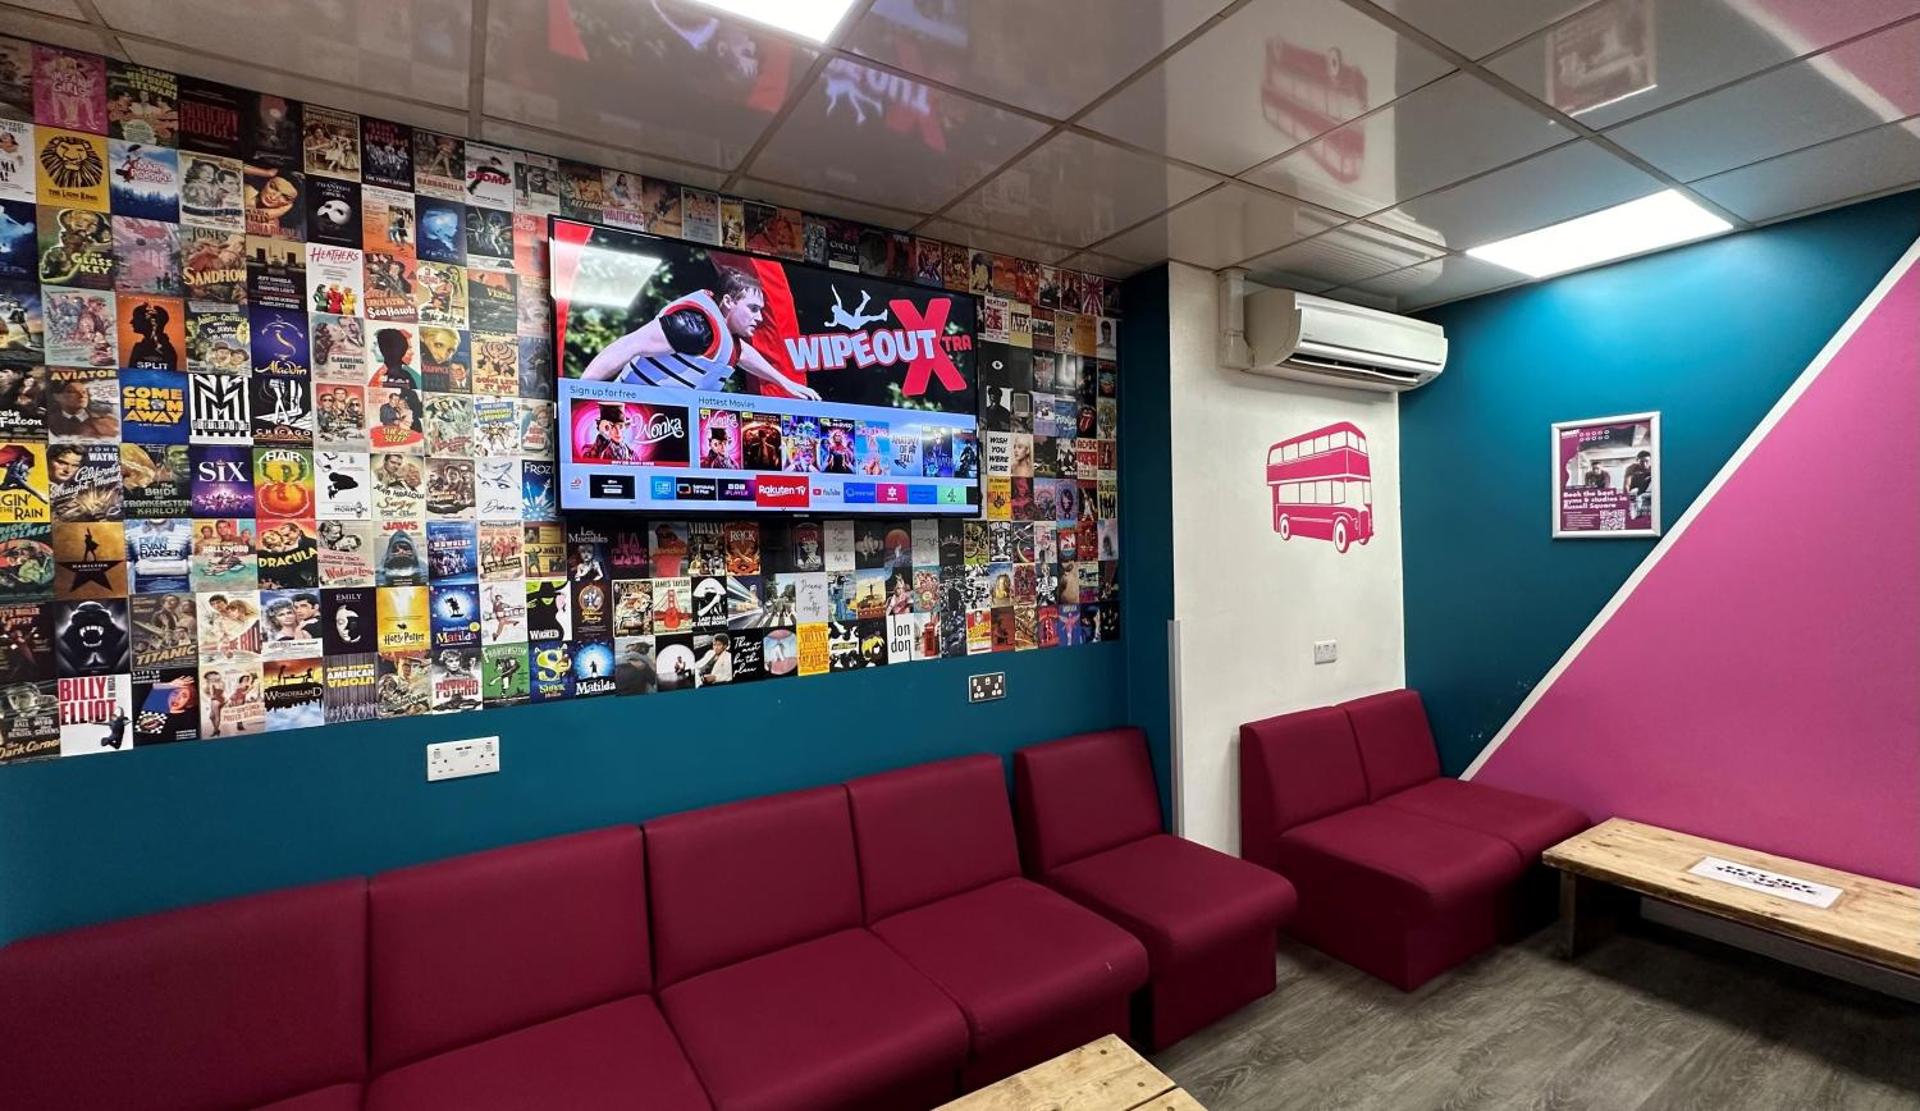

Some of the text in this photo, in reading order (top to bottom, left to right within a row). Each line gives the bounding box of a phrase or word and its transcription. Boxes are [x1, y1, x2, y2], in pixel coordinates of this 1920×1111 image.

[467, 170, 511, 186] STOMP
[191, 227, 229, 241] JONES
[70, 252, 112, 267] GLASS
[310, 247, 360, 263] HEATHERS
[80, 264, 109, 275] KEY
[784, 329, 938, 371] WIPEOUT
[137, 361, 168, 370] SPLIT
[255, 360, 307, 376] Aladdin
[51, 370, 118, 382] AVIATOR
[123, 387, 183, 400] COME
[569, 385, 637, 399] Sign up for free
[123, 399, 184, 411] FROM
[698, 396, 755, 409] Hottest Movies
[123, 411, 184, 424] AWAY
[256, 427, 312, 436] CHICAGO
[632, 412, 684, 443] Wonka
[991, 446, 1006, 454] YOU
[89, 452, 119, 462] WAYNE
[265, 451, 301, 463] HAIR
[989, 455, 1009, 463] WERE
[989, 464, 1009, 472] HERE
[145, 488, 178, 496] BRIDE
[759, 484, 806, 498] Rakuten TV
[124, 499, 192, 508] FRANKENSTEIN
[15, 506, 44, 521] RAIN
[137, 507, 187, 516] KARLOFF
[383, 521, 418, 531] JAWS
[689, 521, 726, 534] NIRVANA
[730, 529, 756, 543] ROCK
[139, 543, 168, 551] EVAN
[203, 545, 249, 553] HOLLYWOOD
[139, 549, 183, 559] HANSEN
[259, 548, 317, 569] DRACULA
[336, 593, 362, 601] EMILY
[894, 614, 911, 637] lon
[436, 629, 478, 646] Matilda
[530, 629, 559, 640] WICKED
[136, 645, 196, 665] TITANIC
[891, 637, 912, 661] don
[327, 668, 375, 680] AMERICAN
[60, 675, 107, 702] BILLY
[328, 677, 374, 689] UTOPIA
[575, 680, 616, 696] Matilda
[265, 688, 322, 701] WONDERLAND
[60, 698, 117, 726] ELLIOT
